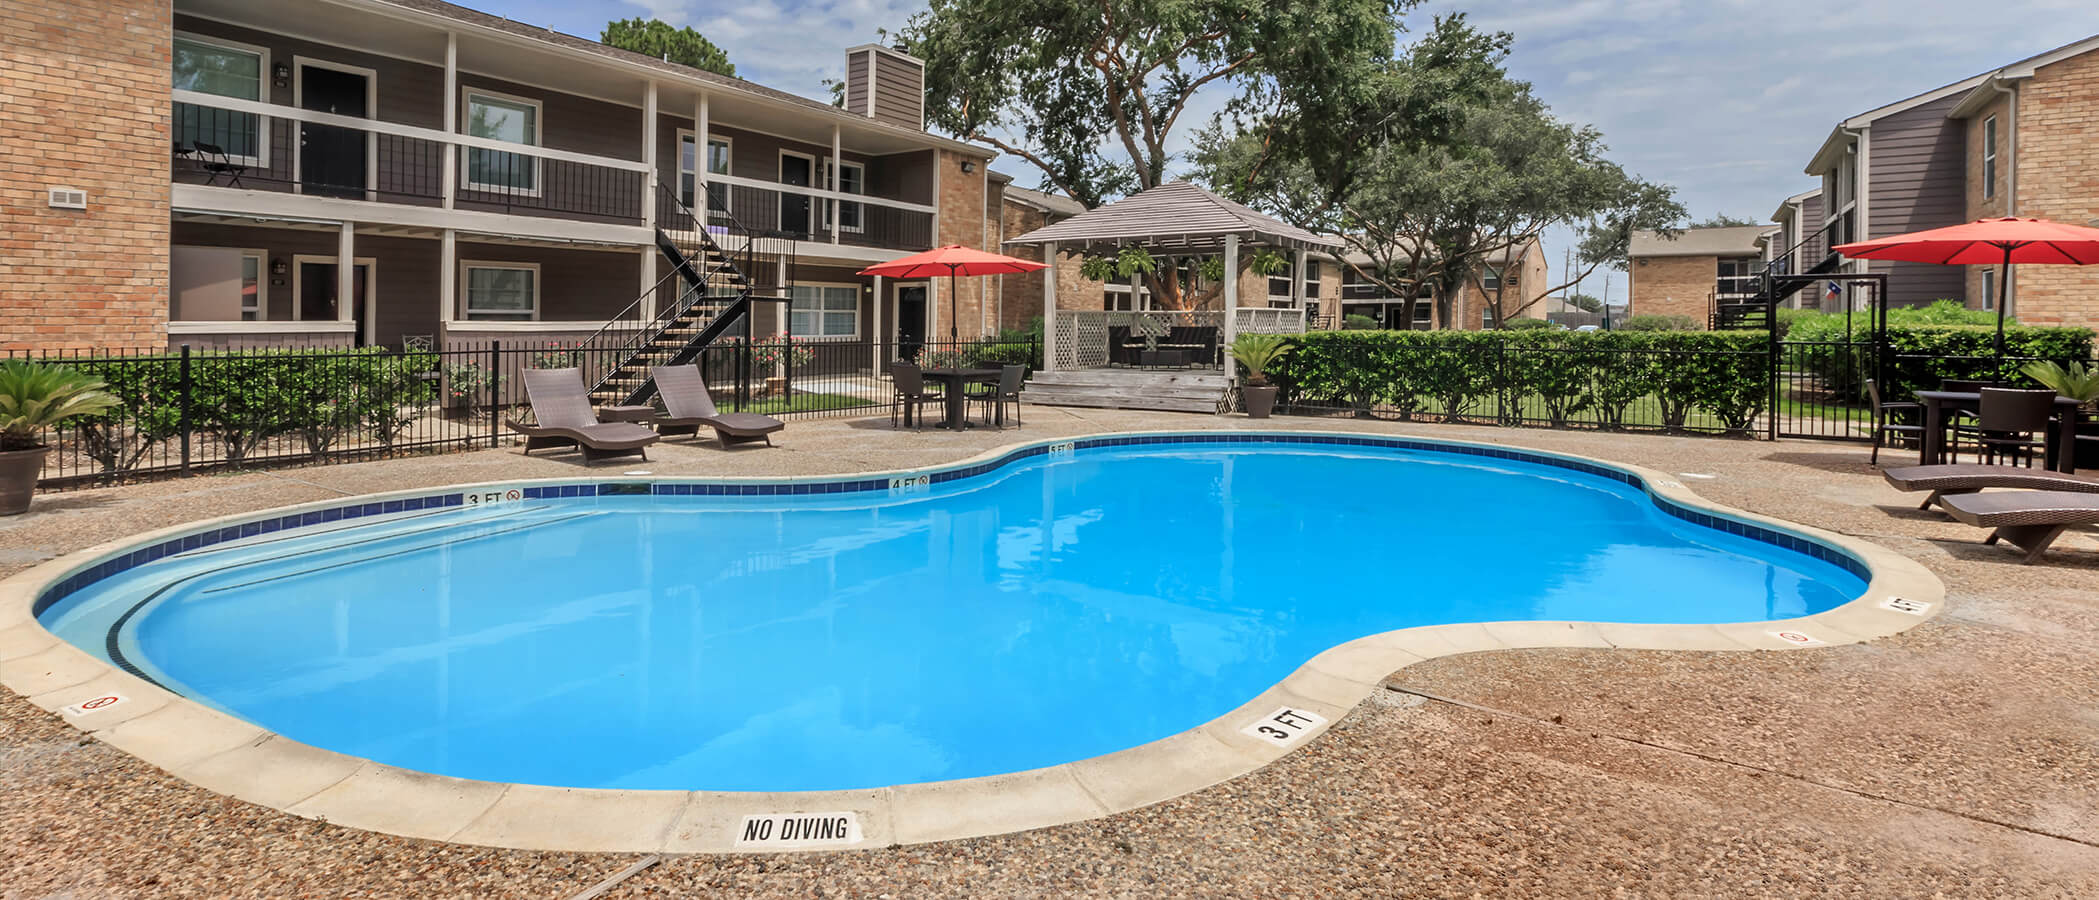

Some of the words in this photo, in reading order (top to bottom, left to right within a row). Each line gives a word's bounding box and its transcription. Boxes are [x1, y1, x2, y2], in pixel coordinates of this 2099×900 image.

[892, 479, 900, 489] 4
[904, 477, 916, 488] FT
[469, 494, 479, 504] 3
[485, 491, 502, 503] FT
[1257, 725, 1289, 739] 3
[1273, 709, 1313, 730] FT
[743, 818, 773, 841] NO
[780, 817, 848, 841] DIVING
